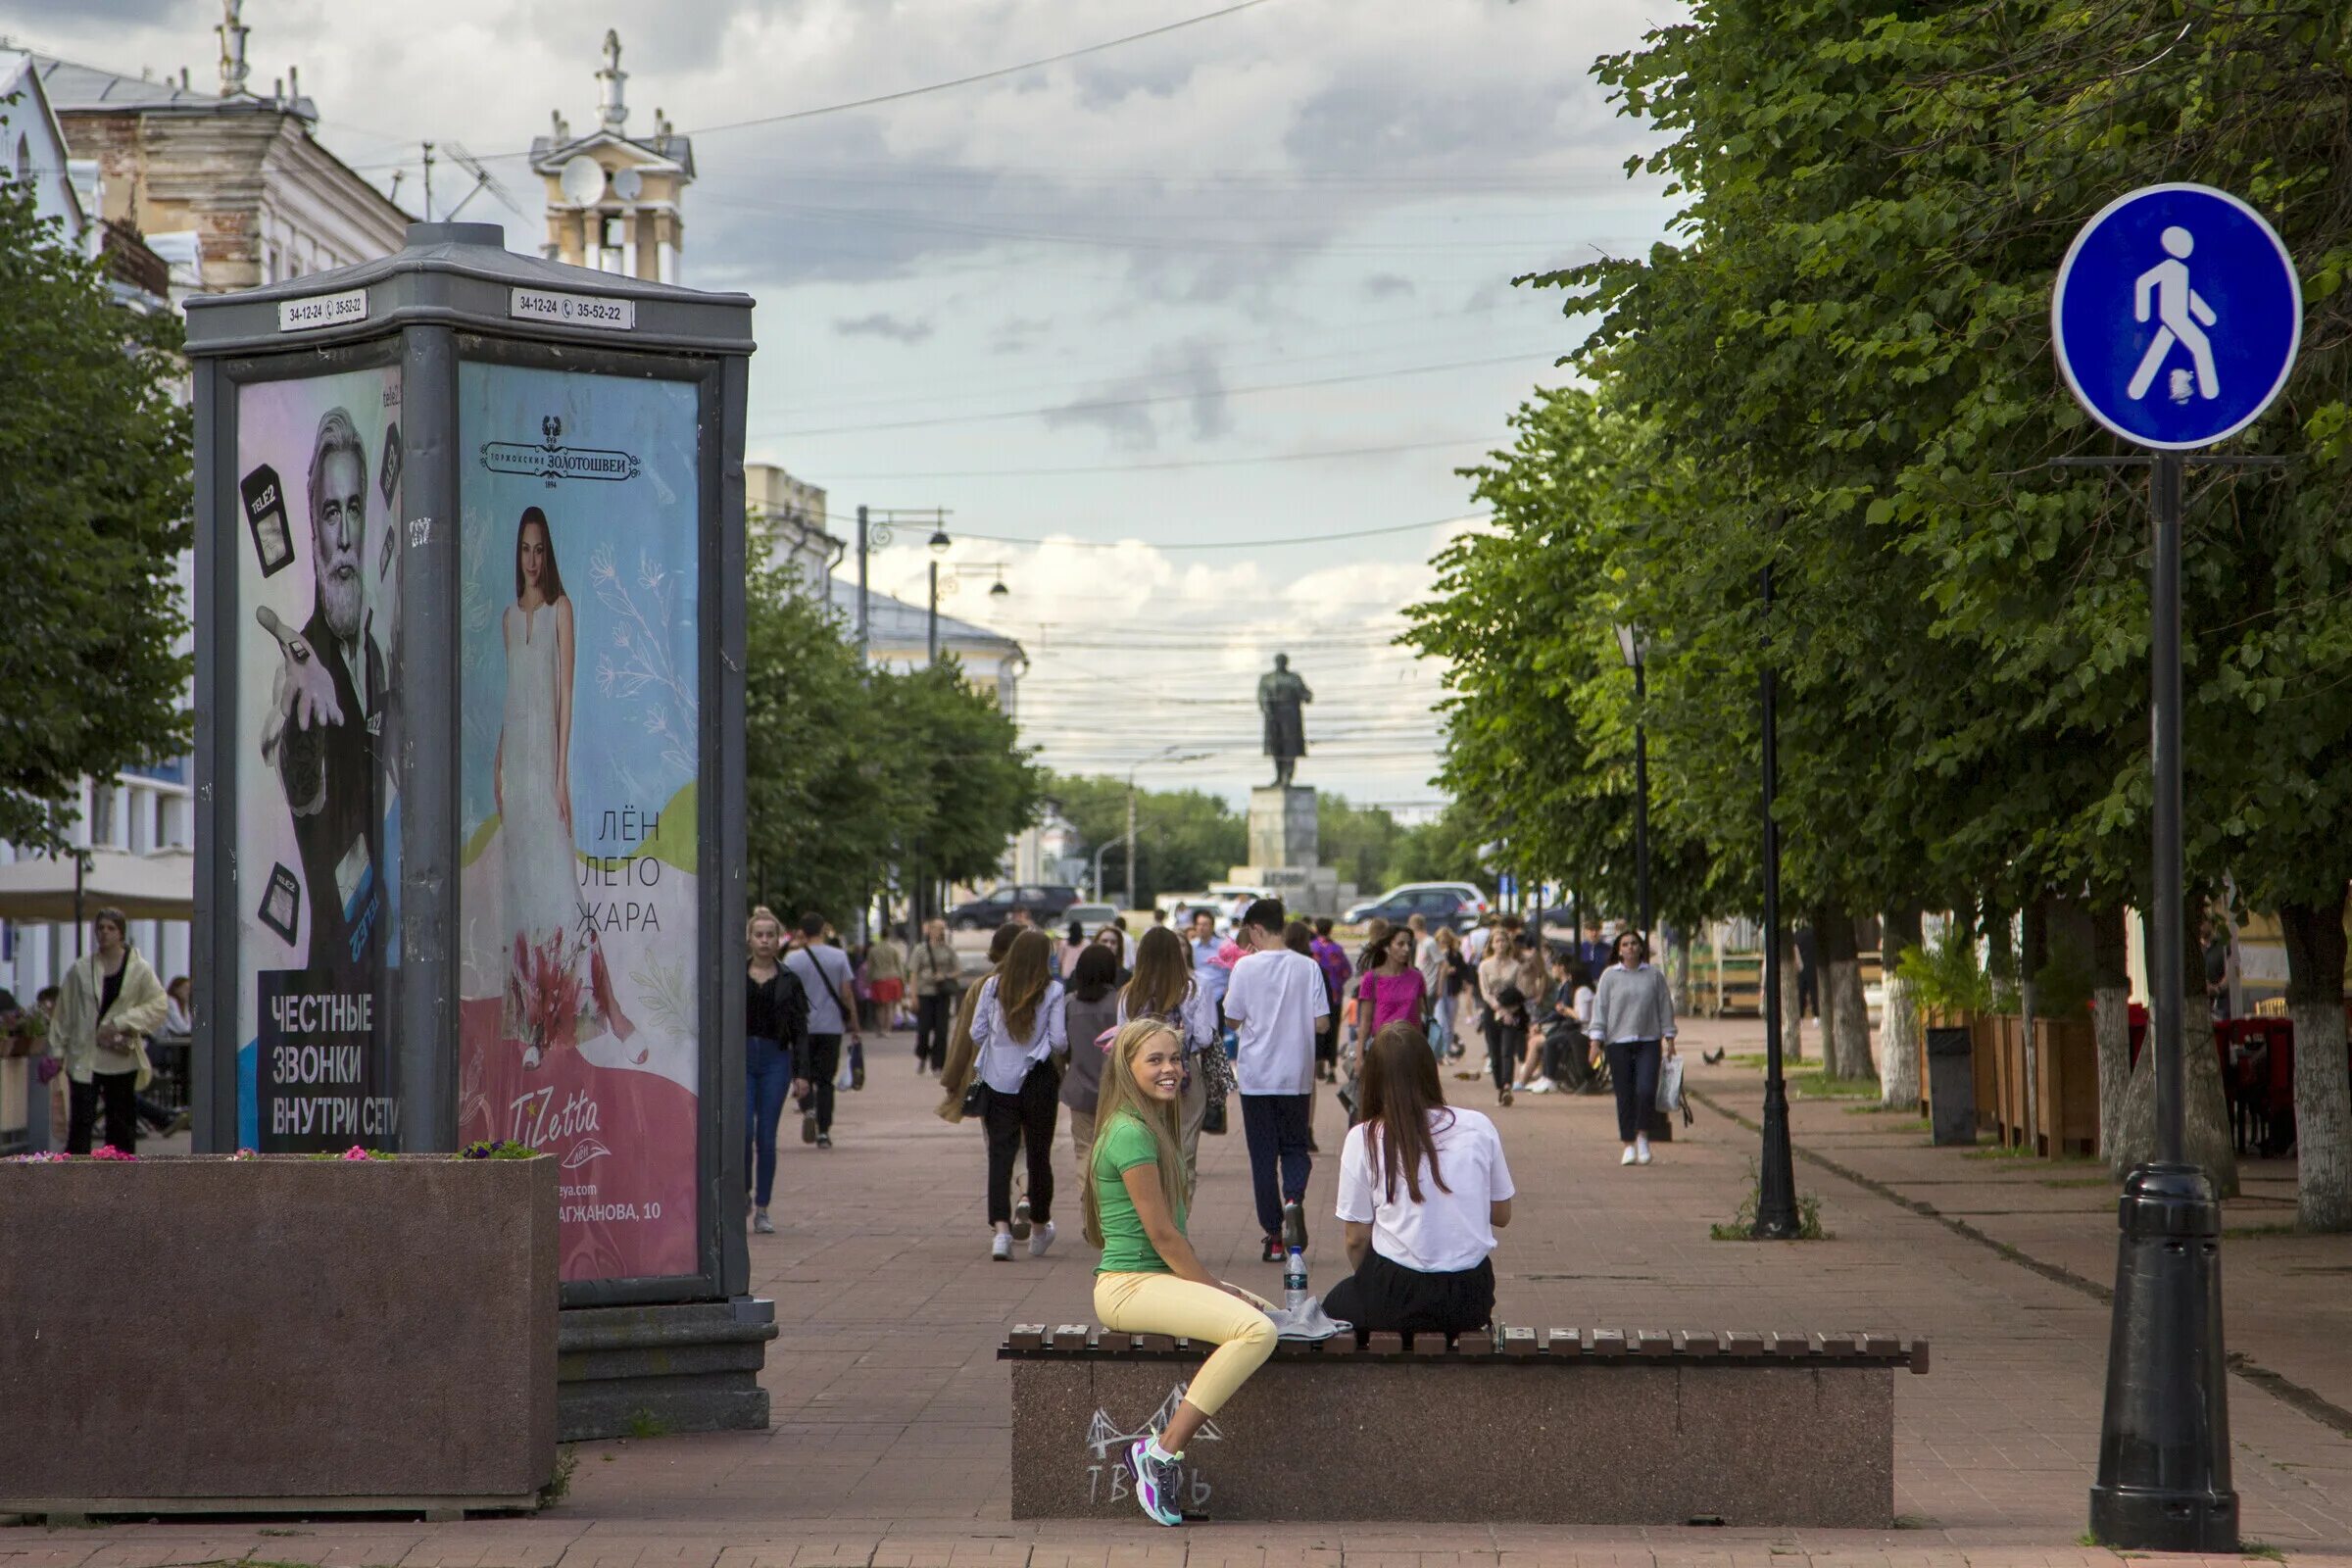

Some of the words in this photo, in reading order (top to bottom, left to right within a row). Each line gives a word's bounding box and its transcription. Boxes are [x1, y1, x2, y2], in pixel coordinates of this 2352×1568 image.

[289, 303, 322, 321] 34-12-24
[335, 298, 361, 315] 35-52-22
[519, 296, 558, 314] 34-12-24
[576, 303, 621, 320] 35-52-22
[490, 453, 545, 466] ТОРЖОКСКИЕ
[547, 456, 626, 473] ЗОЛОТОШВЕИ
[251, 484, 276, 515] TELE2
[545, 480, 558, 489] 1894
[598, 805, 660, 842] ЛЁН
[275, 872, 297, 892] TELE2
[581, 856, 661, 887] ЛЕТО
[349, 892, 380, 963] TELE2
[576, 902, 661, 932] ЖАРА
[270, 993, 373, 1033] ЧЕСТНЫЕ
[271, 1045, 362, 1085] ЗВОНКИ
[272, 1097, 358, 1135] ВНУТРИ
[643, 1202, 662, 1219] 10
[1087, 1462, 1212, 1505] ТВЬ
